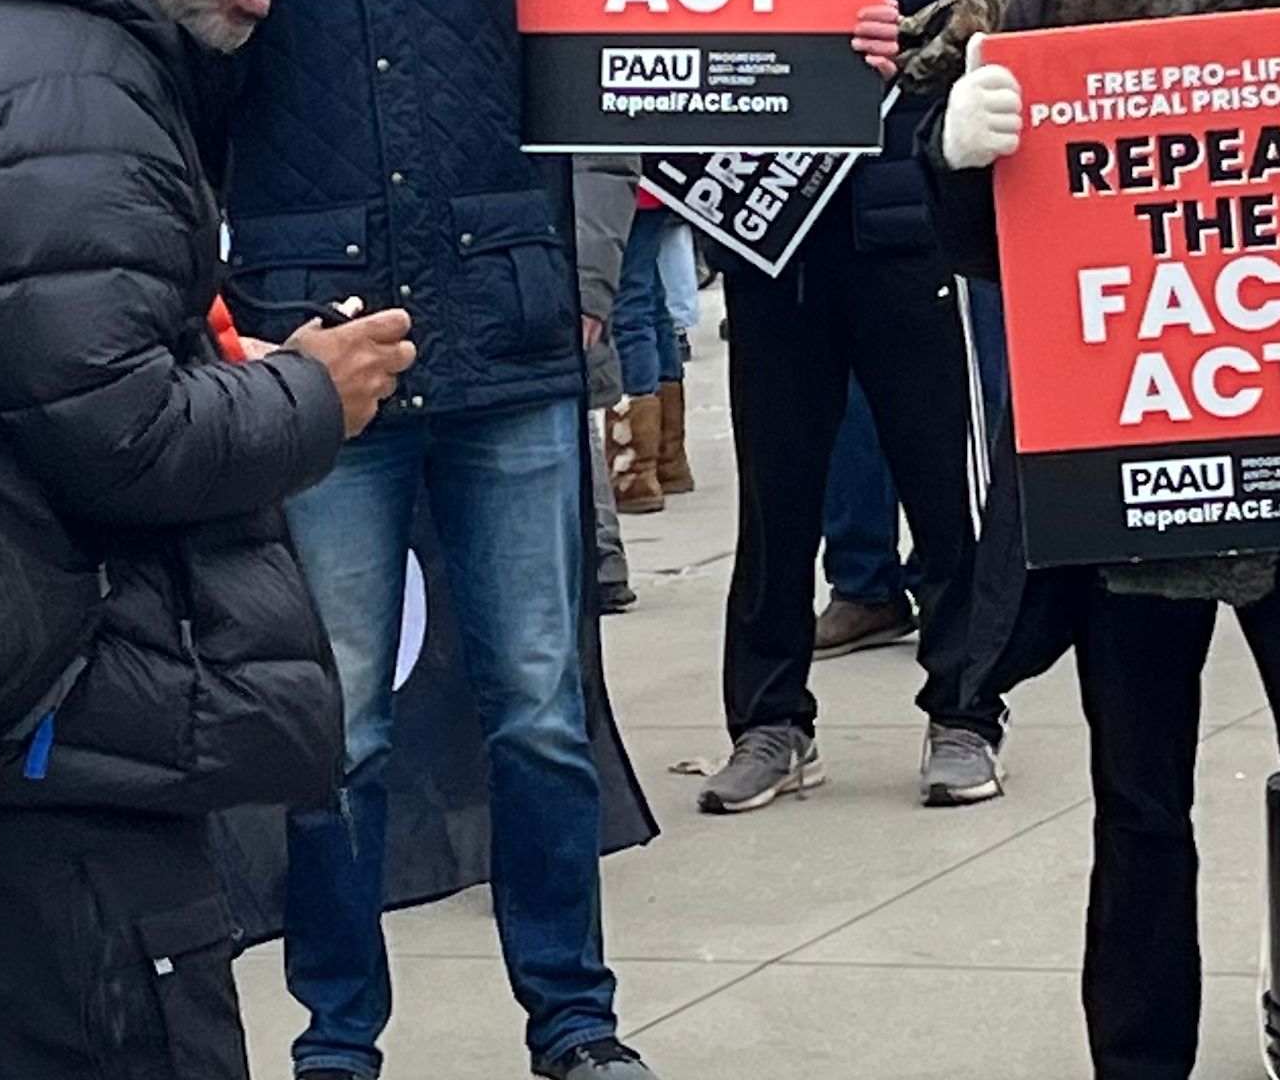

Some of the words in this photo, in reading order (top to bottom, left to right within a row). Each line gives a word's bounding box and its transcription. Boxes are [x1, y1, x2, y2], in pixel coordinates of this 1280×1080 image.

[608, 54, 694, 82] PAAU
[1087, 69, 1158, 96] FREE
[601, 91, 790, 117] RepealFACE.com
[1030, 94, 1188, 127] POLITICAL
[684, 152, 764, 225] PR
[733, 152, 816, 242] GENE
[1134, 192, 1280, 257] THE
[1129, 462, 1225, 496] PAAU
